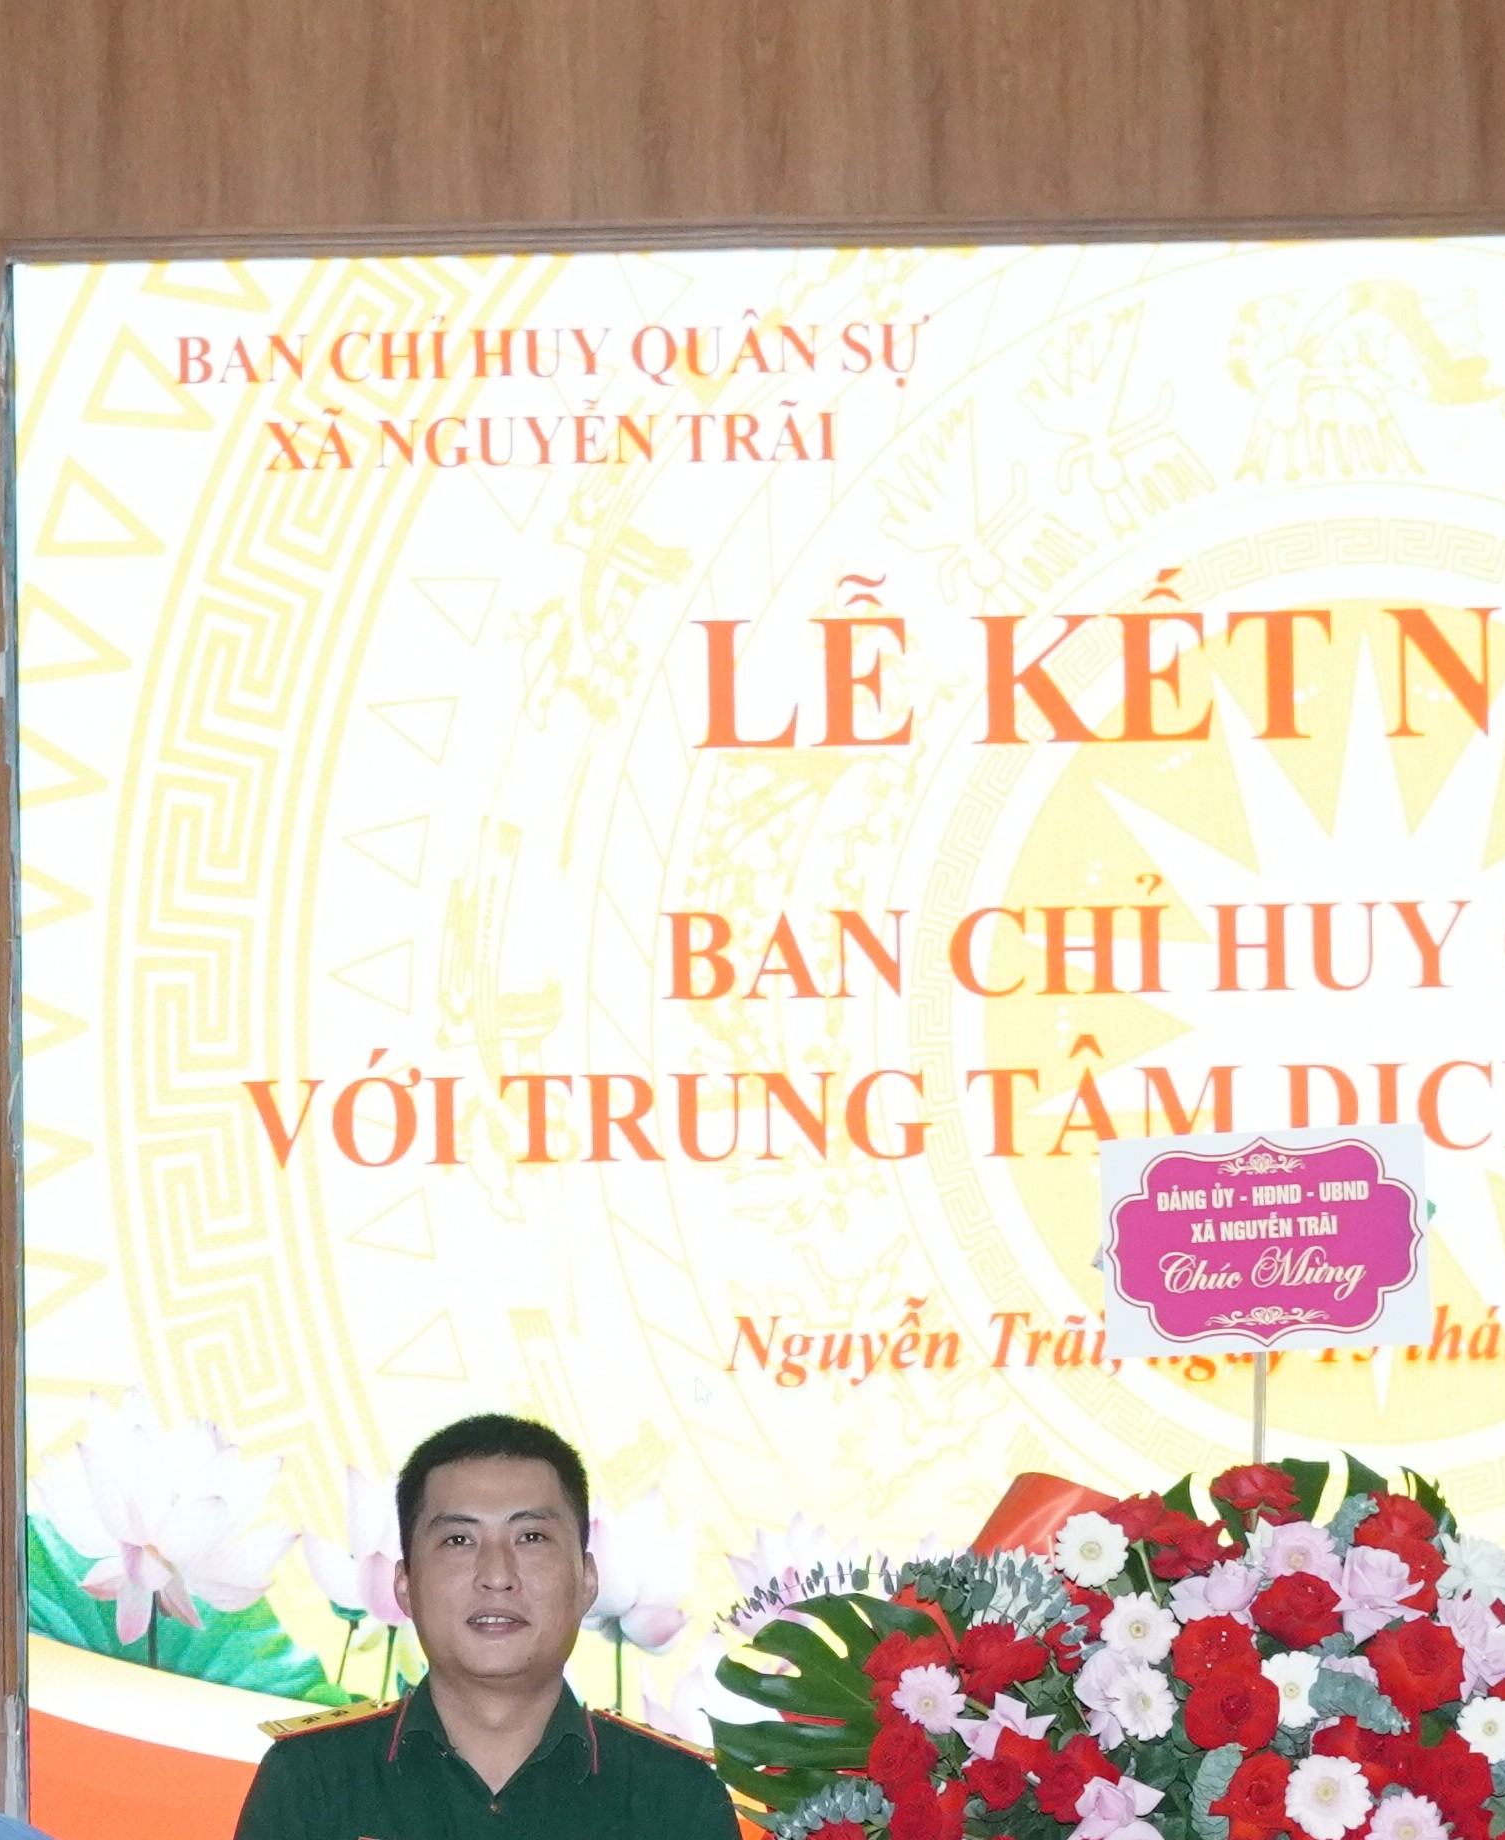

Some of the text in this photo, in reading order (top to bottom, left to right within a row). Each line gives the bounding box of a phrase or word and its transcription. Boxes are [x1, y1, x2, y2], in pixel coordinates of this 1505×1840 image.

[176, 308, 931, 388] BAN CHỈ HUY QUÂN SỰ
[265, 399, 835, 471] XÃ NGUYỄN TRÃI
[694, 574, 914, 749] LỄ
[974, 568, 1332, 745] KẾT
[664, 910, 909, 1001] BAN
[949, 874, 1167, 998] CHỈ
[1212, 900, 1469, 992] HUY
[241, 1047, 463, 1169] VỚI
[500, 1069, 932, 1163] TRUNG
[965, 1033, 1241, 1159] TÂM
[1156, 1184, 1207, 1212] ĐẢNG
[1211, 1182, 1235, 1209] ỦY
[1251, 1183, 1302, 1207] HĐND
[1318, 1179, 1370, 1203] UBND
[1190, 1211, 1338, 1244] XÃ NGUYỄN TRÃI
[1158, 1245, 1367, 1301] Chúc Mừng
[725, 1297, 960, 1387] Nguyễn
